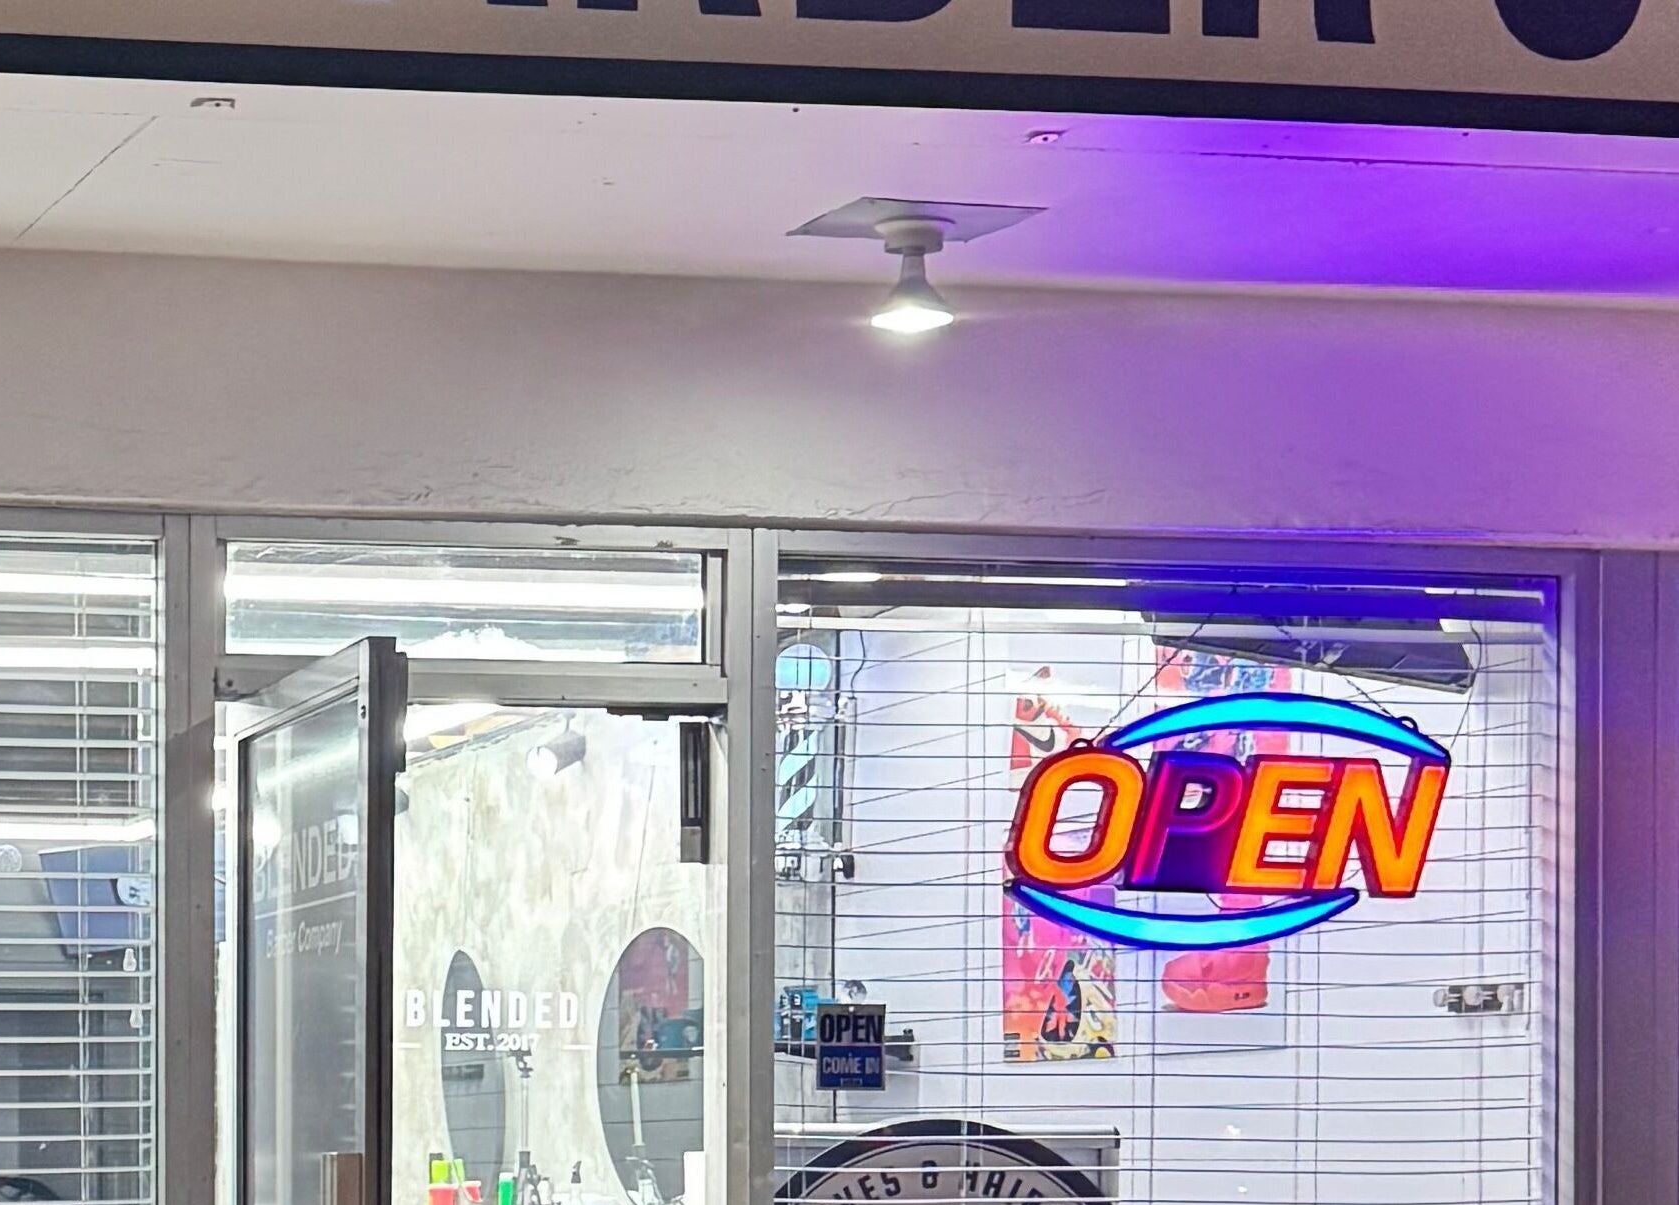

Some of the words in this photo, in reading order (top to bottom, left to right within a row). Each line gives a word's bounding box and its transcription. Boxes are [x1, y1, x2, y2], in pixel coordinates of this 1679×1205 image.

[1007, 745, 1452, 898] OPEN
[298, 920, 343, 956] Company
[404, 989, 579, 1029] BLENDED
[820, 1013, 883, 1044] OPEN
[822, 1056, 862, 1075] COME
[865, 1056, 881, 1075] IN
